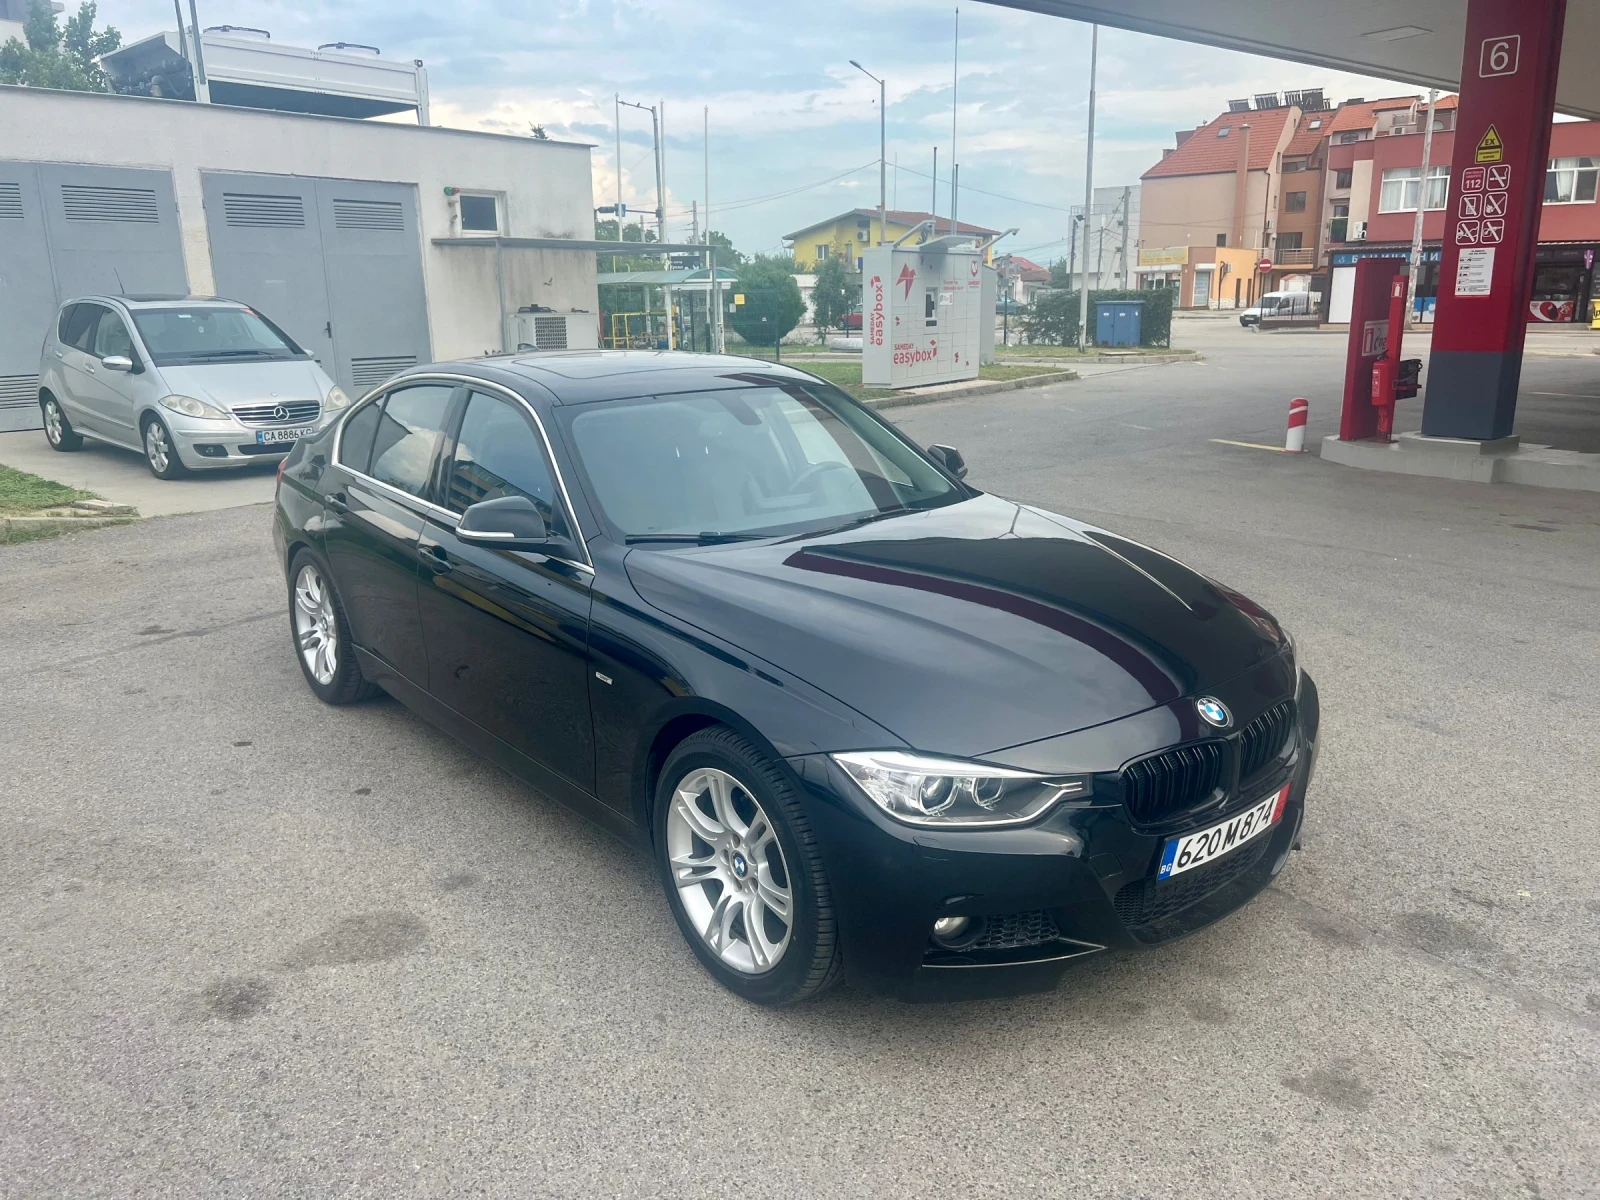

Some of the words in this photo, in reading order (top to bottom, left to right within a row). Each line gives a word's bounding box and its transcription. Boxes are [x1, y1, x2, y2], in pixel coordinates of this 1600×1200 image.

[1490, 41, 1509, 71] 6
[1465, 179, 1481, 189] 112
[873, 285, 885, 346] easybox
[893, 348, 932, 367] easybox
[1159, 863, 1172, 874] BG
[1177, 797, 1273, 869] 620M874
